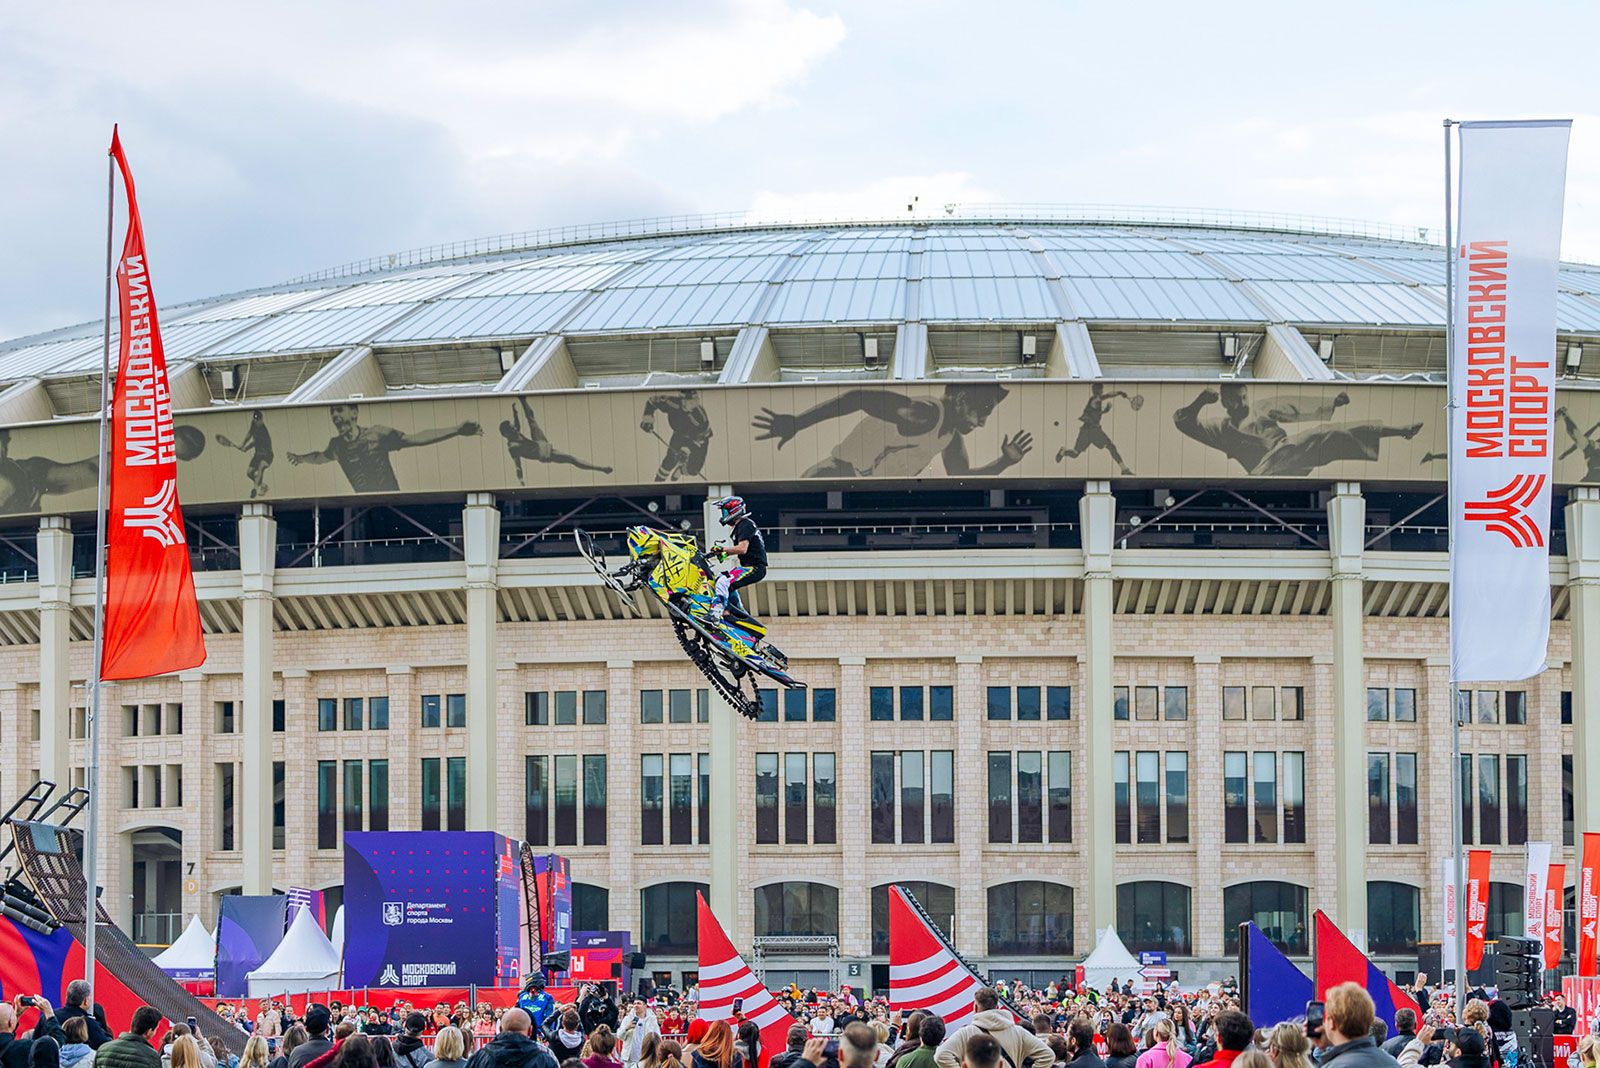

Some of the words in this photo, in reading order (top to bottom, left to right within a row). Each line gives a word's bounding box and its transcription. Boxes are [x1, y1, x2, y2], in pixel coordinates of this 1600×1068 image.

[120, 253, 157, 467] МОСКОВСКИЙ
[1460, 240, 1508, 458] МОСКОВСКИЙ
[153, 364, 177, 465] СПОРТ
[1508, 355, 1549, 457] СПОРТ
[187, 862, 196, 875] 7
[1527, 872, 1537, 919] МОСКОВСКИЙ
[402, 961, 456, 975] МОСКОВСКИЙ
[402, 975, 428, 986] СПОРТ
[851, 965, 858, 975] 3
